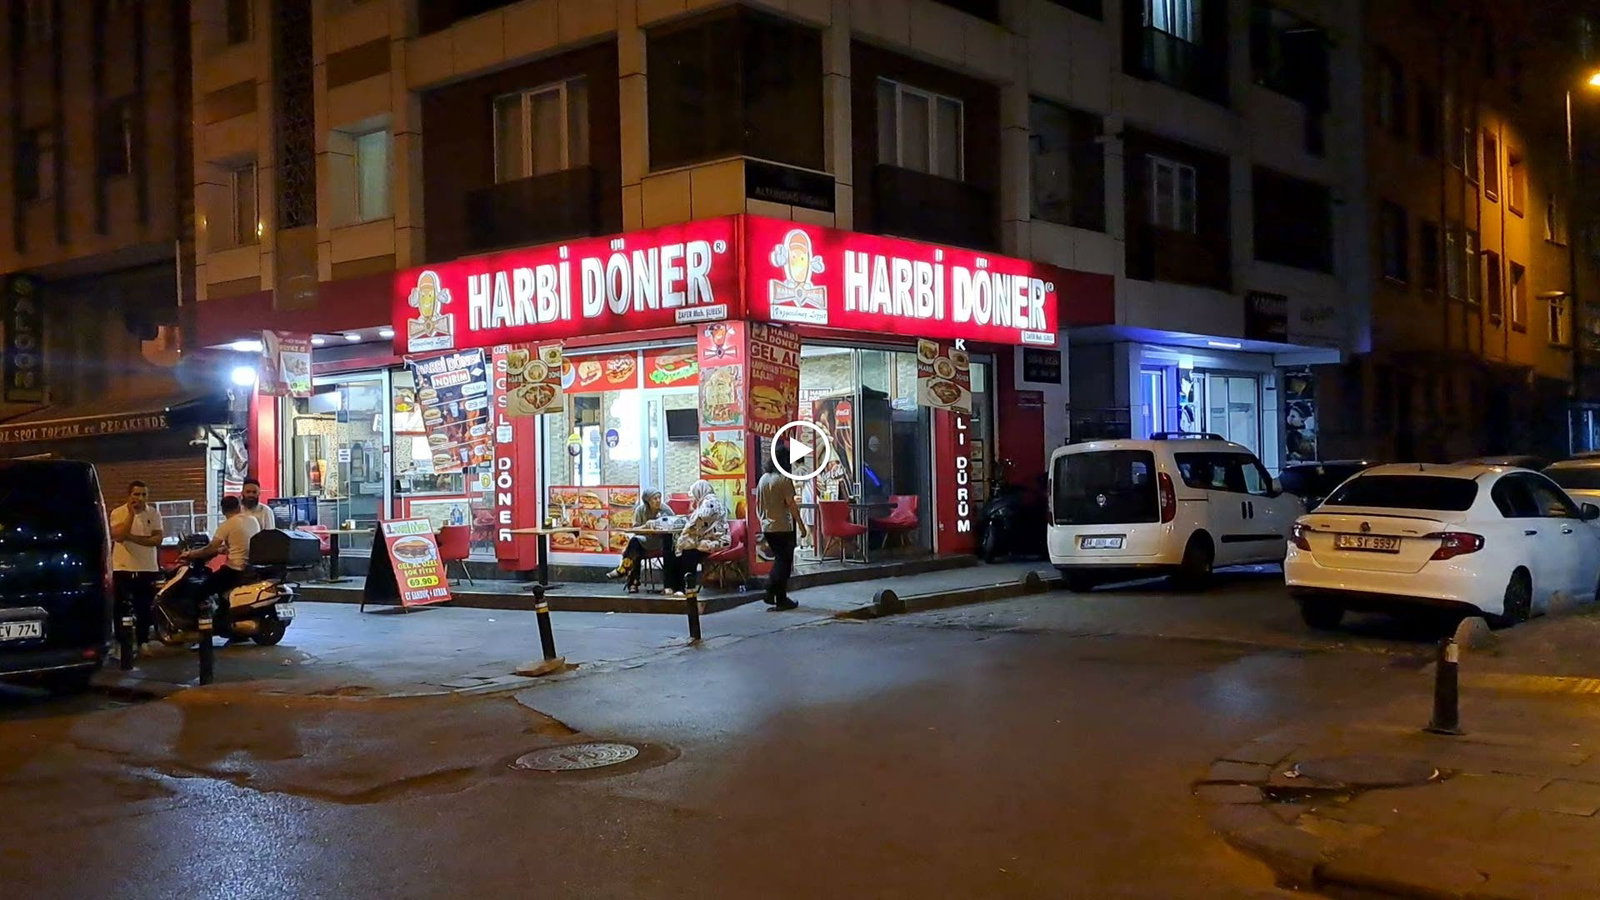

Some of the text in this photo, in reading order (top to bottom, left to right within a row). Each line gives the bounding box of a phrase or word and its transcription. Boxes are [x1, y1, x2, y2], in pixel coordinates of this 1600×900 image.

[467, 246, 571, 330] HARBİ
[581, 238, 713, 318] DÖNER
[845, 249, 944, 319] HARBİ
[953, 258, 1046, 329] DÖNER
[750, 341, 778, 362] GEL
[782, 350, 799, 369] AL
[14, 428, 37, 442] SPOT
[498, 457, 512, 542] DÖNER
[956, 456, 970, 533] DÜRÜM
[409, 578, 432, 586] 69.90
[18, 624, 37, 636] 774
